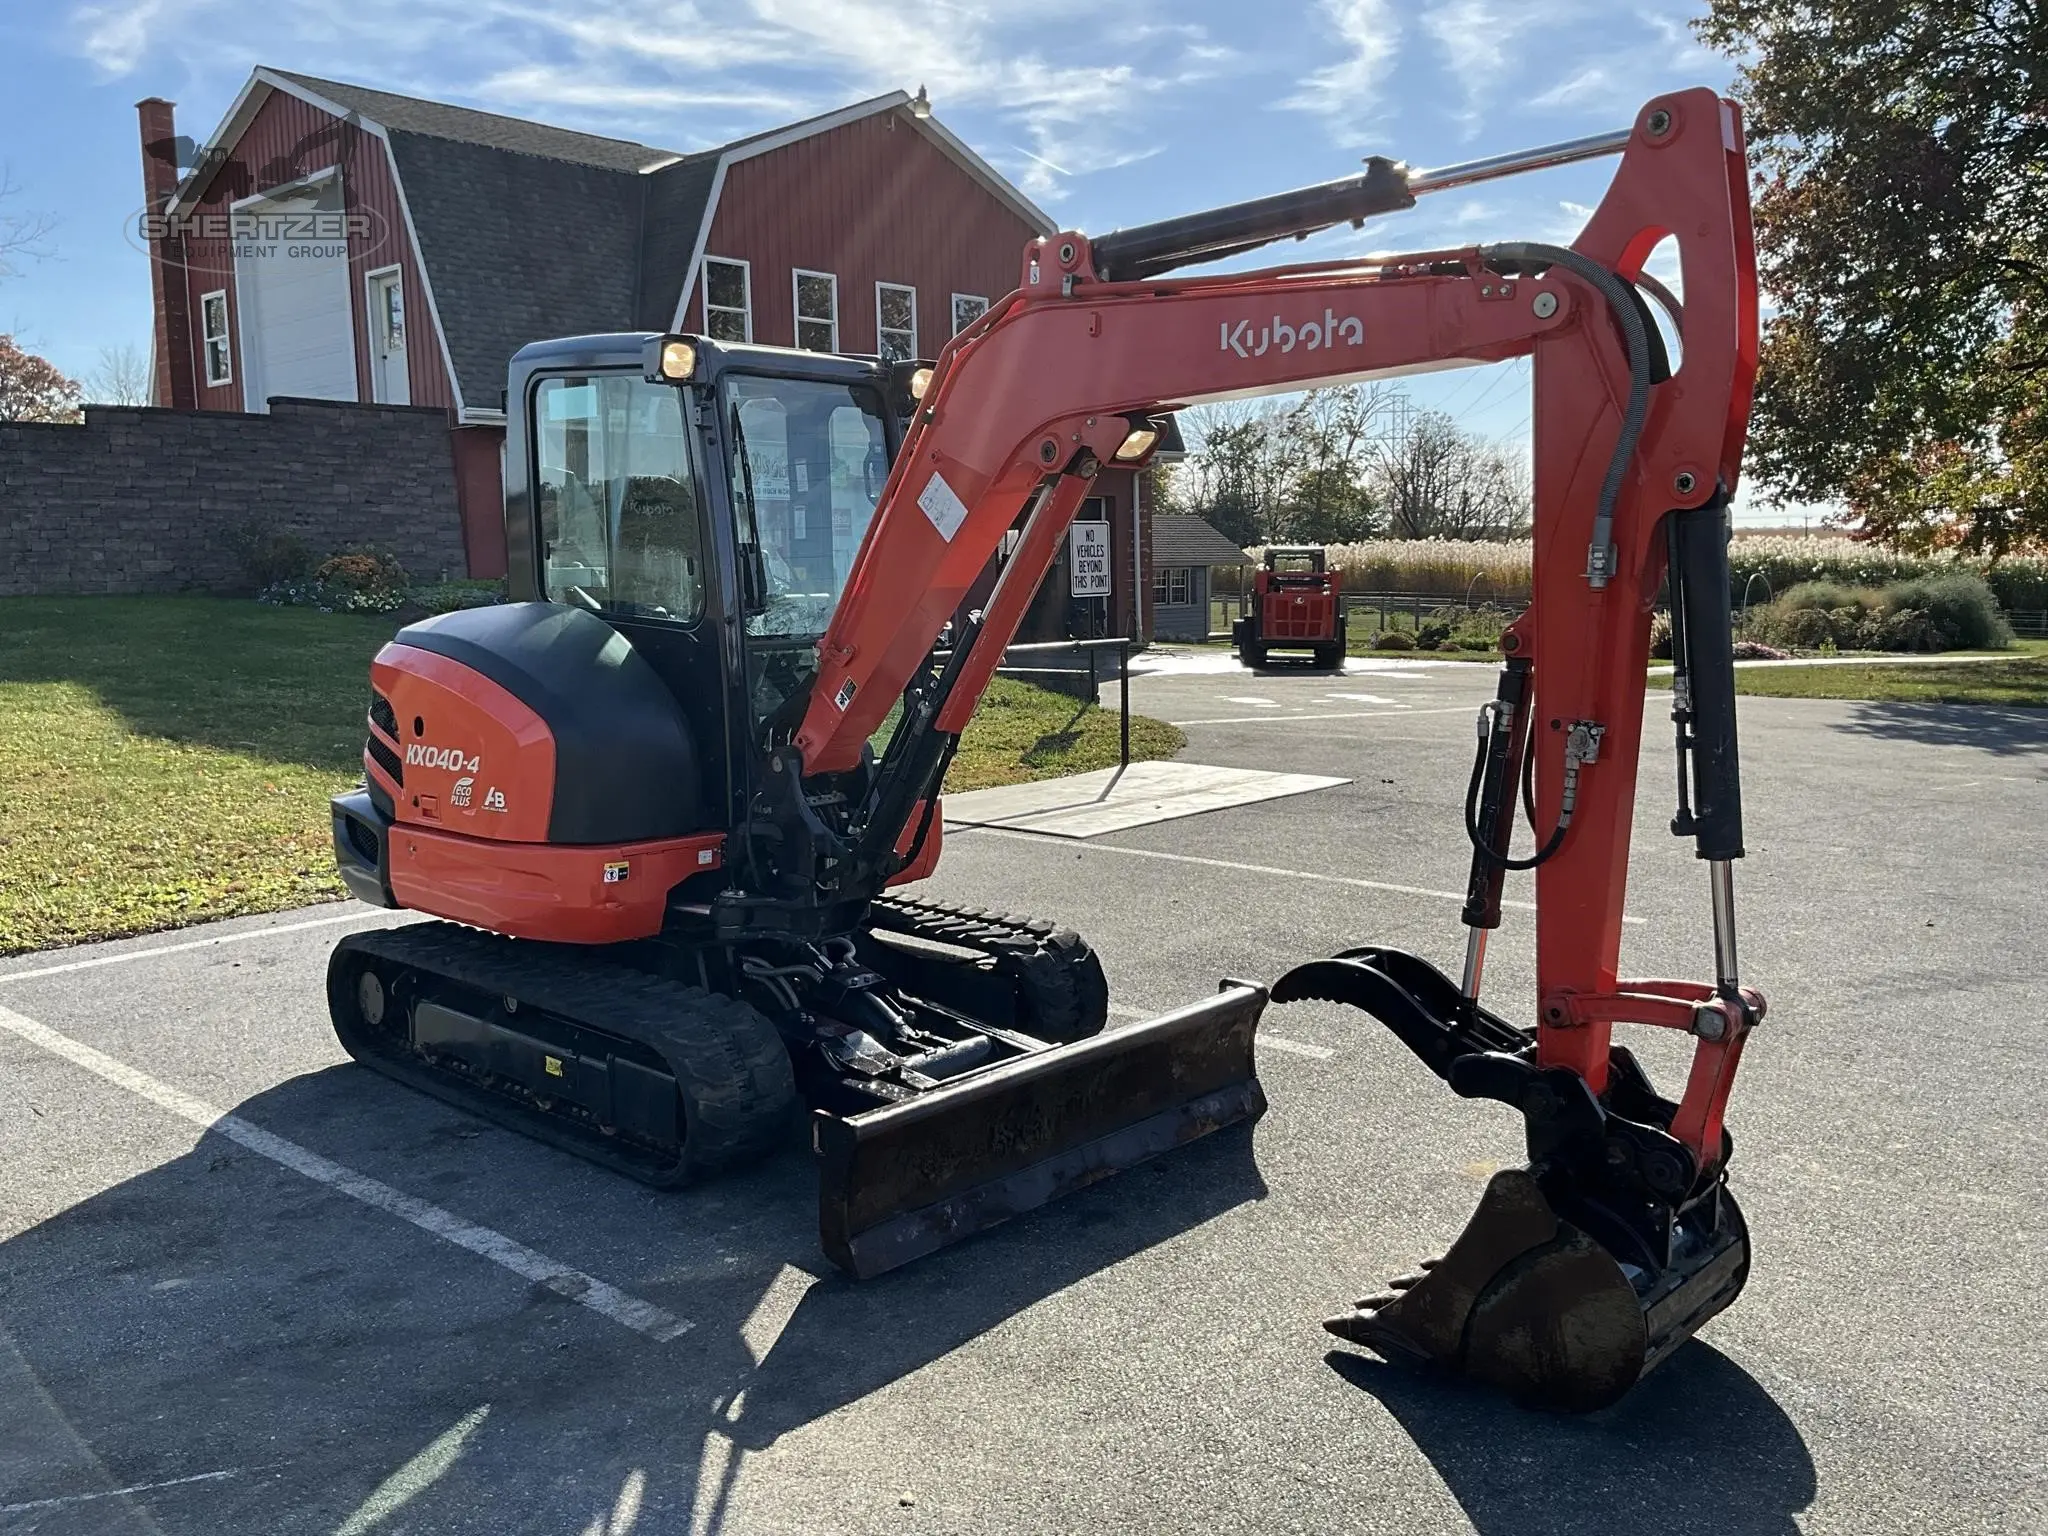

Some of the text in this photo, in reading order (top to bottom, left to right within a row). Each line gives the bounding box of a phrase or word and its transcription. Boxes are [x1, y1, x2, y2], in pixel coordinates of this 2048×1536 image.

[1220, 308, 1363, 358] Kubota
[1086, 530, 1095, 542] NO
[1076, 545, 1105, 557] VEHICLES
[1078, 560, 1103, 573] BEYOND
[1074, 575, 1107, 589] THIS POINT
[406, 744, 481, 774] KX040-4
[455, 785, 472, 796] eco
[450, 795, 471, 807] PLUS
